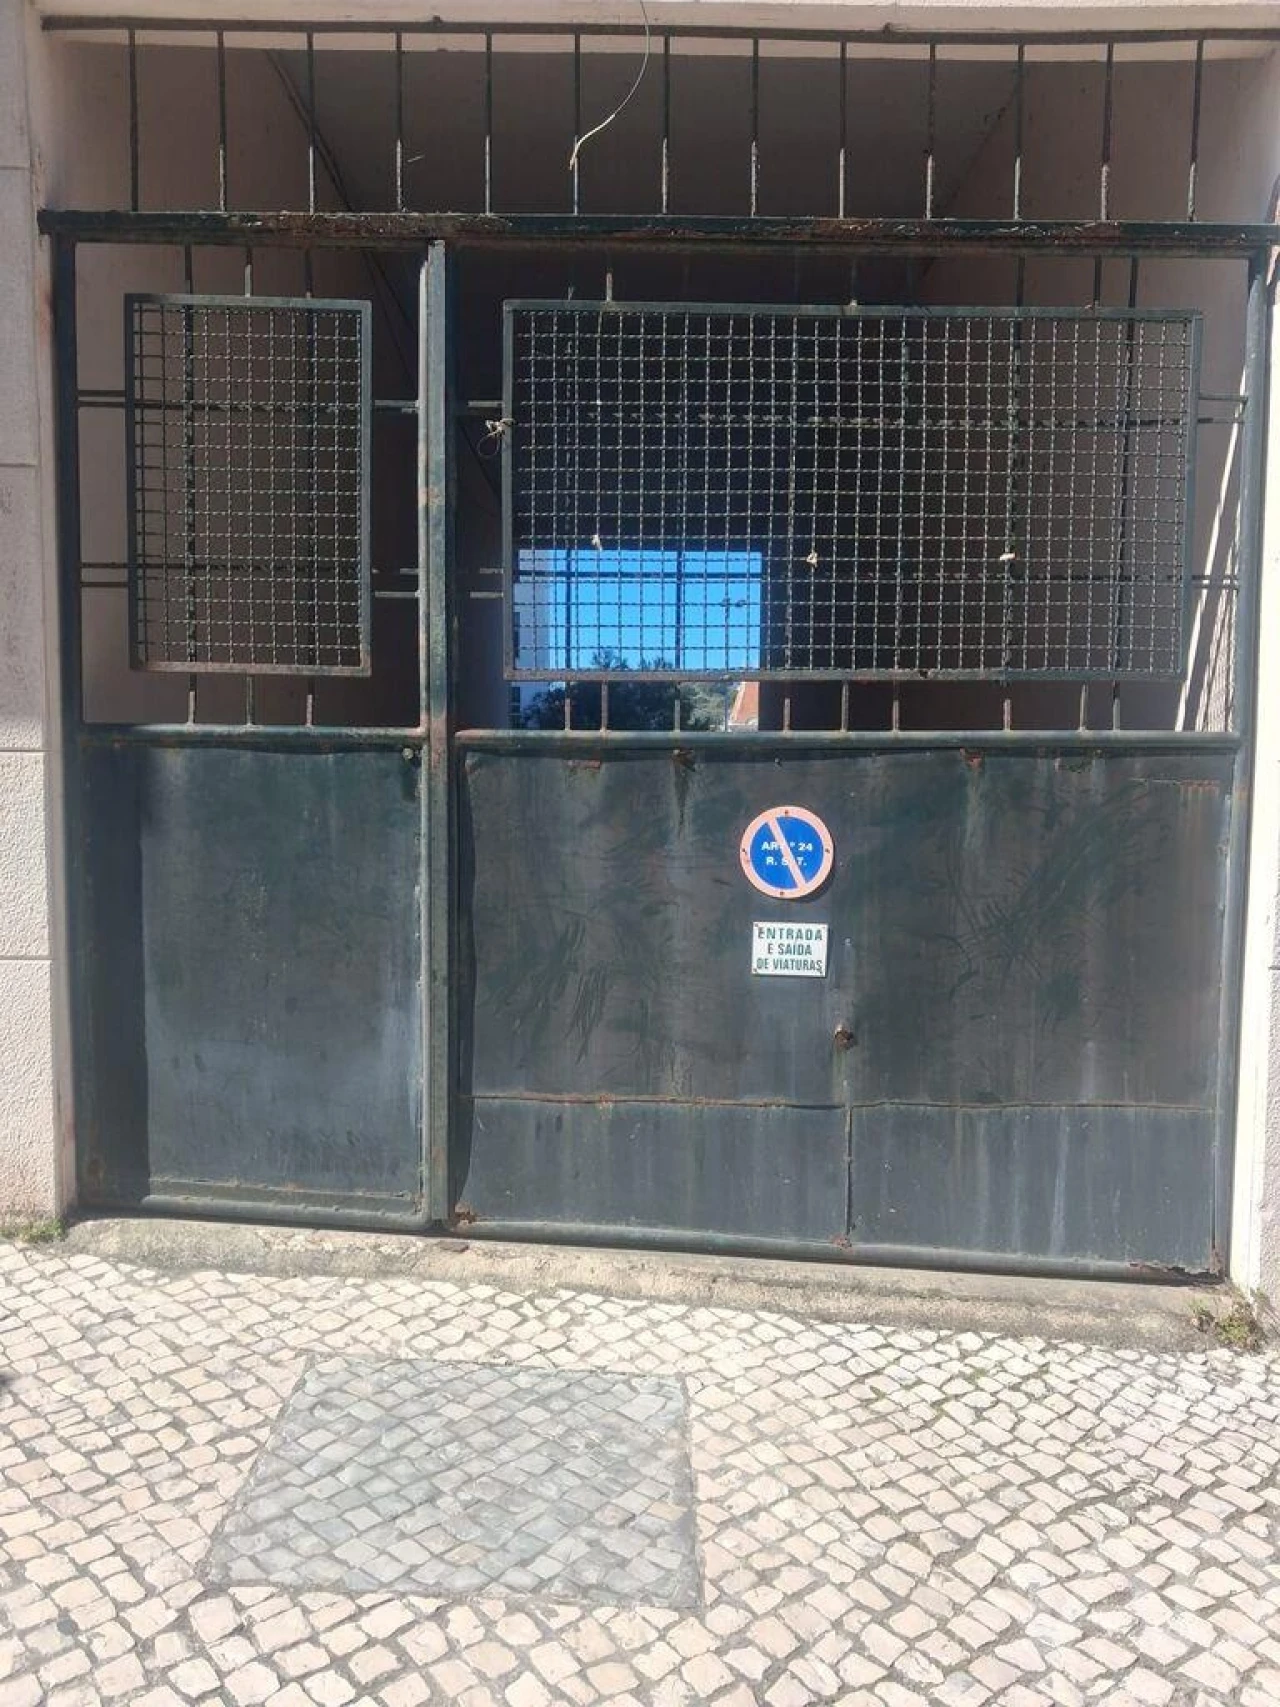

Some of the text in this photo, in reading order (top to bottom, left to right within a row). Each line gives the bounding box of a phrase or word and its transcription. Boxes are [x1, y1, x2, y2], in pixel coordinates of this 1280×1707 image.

[798, 842, 813, 851] 24
[757, 927, 823, 941] ENTRADA
[767, 943, 774, 954] E
[756, 958, 823, 971] DE VIATURAS
